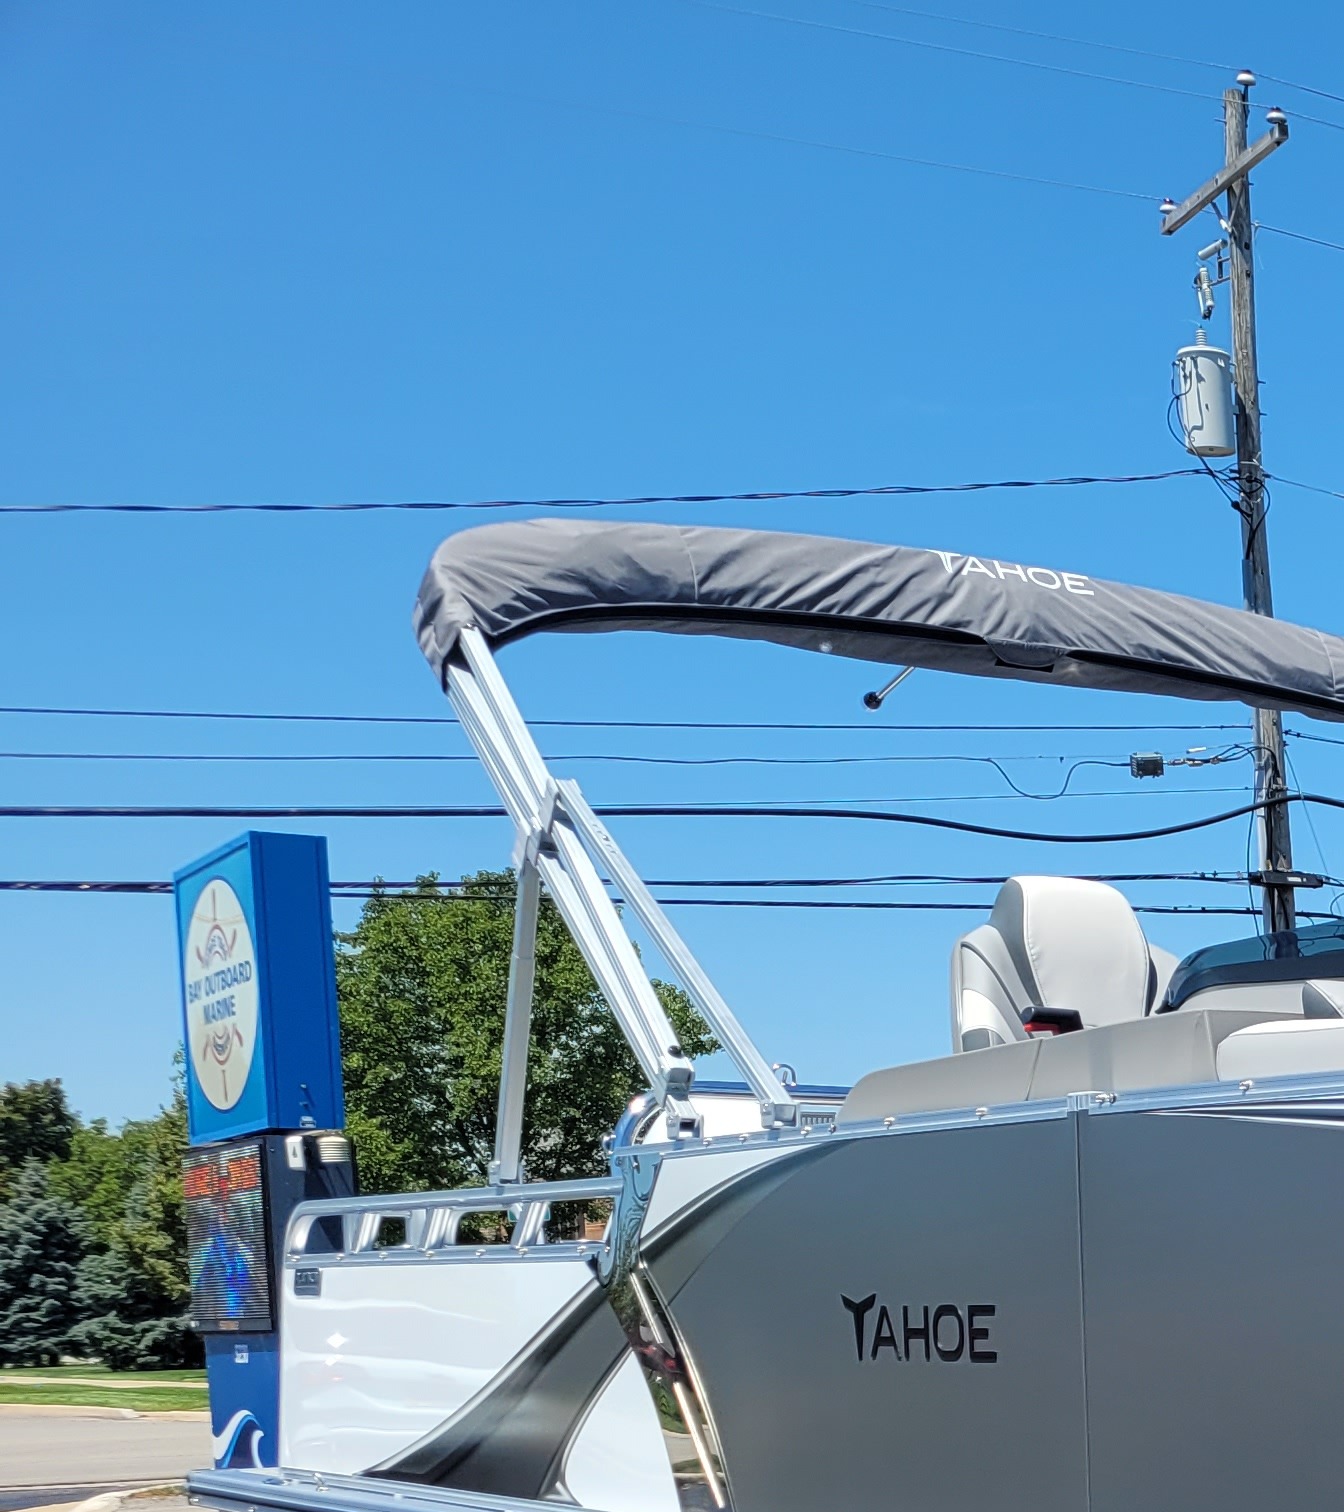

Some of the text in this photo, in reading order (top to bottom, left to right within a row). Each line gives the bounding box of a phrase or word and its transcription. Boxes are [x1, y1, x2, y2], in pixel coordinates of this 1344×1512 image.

[925, 549, 1094, 596] TAHOE
[188, 960, 251, 1004] BAY OUTBOARD
[203, 995, 236, 1025] MARINE
[840, 1292, 998, 1364] TAHOE
